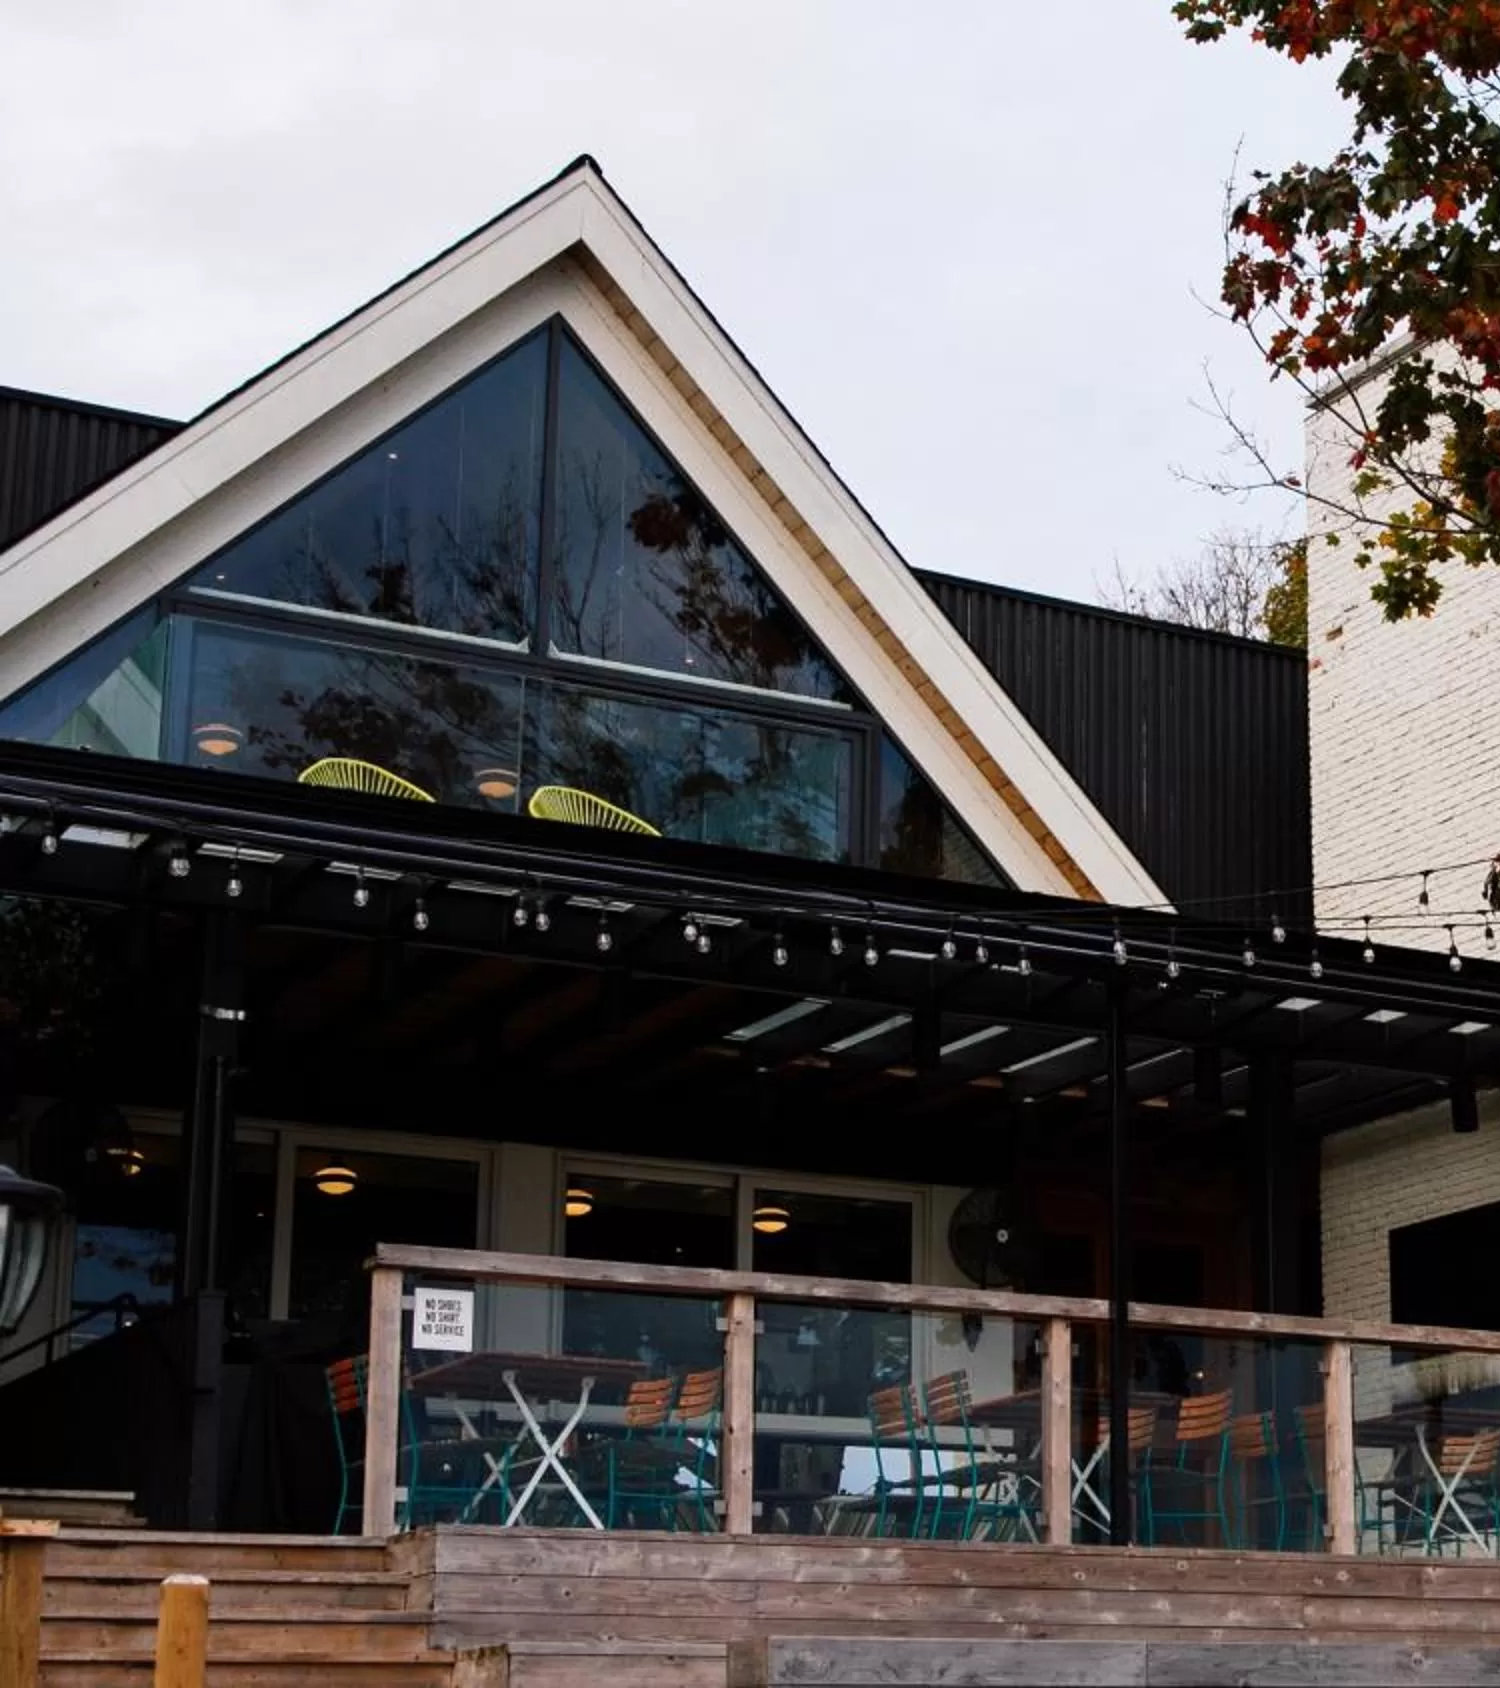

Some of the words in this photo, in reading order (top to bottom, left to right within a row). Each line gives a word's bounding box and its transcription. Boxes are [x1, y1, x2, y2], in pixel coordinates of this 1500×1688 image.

[426, 1299, 436, 1310] NO
[426, 1311, 436, 1322] NO
[422, 1323, 432, 1335] NO
[434, 1324, 464, 1336] SERVICE
